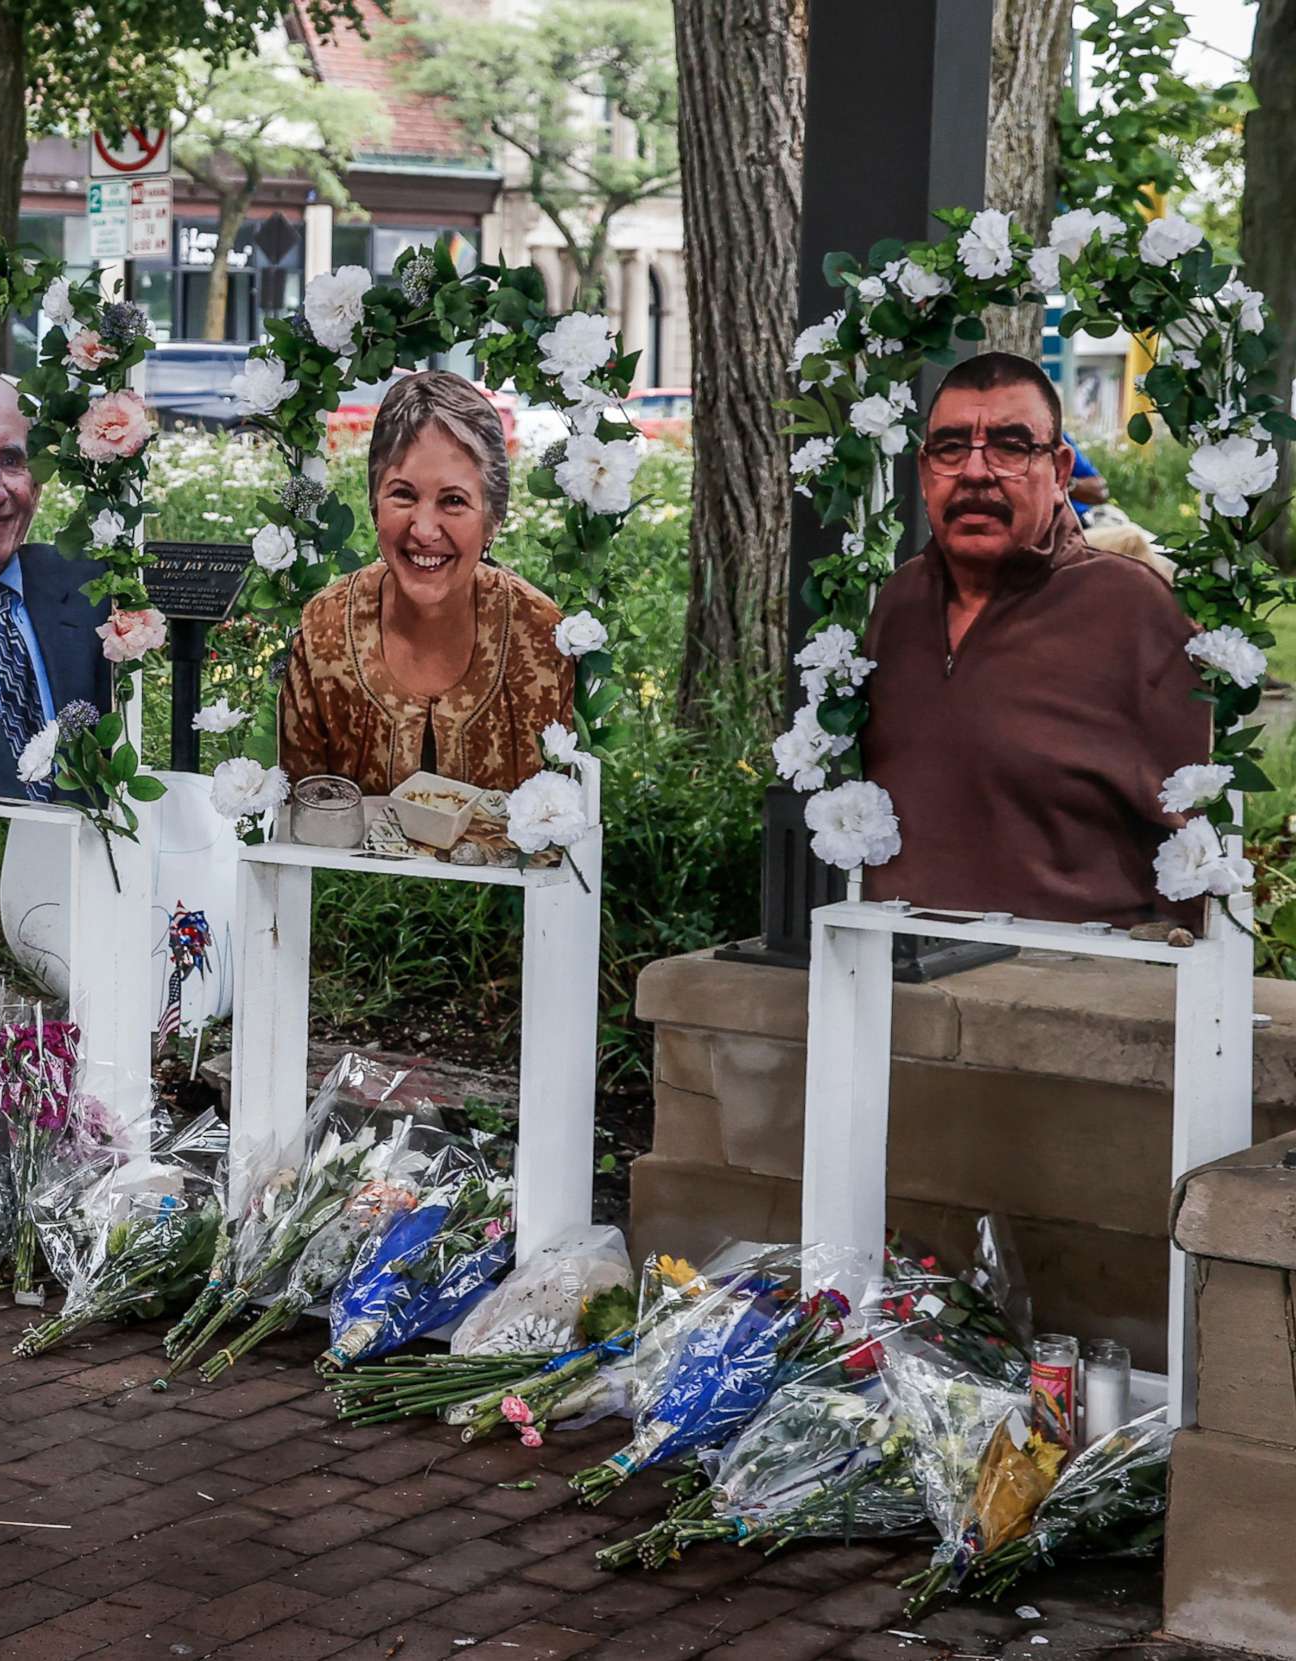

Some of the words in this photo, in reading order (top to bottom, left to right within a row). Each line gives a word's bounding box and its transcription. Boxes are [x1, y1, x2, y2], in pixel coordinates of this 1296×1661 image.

[91, 189, 100, 208] 2
[183, 561, 205, 571] JAY
[208, 562, 244, 572] TOBIN
